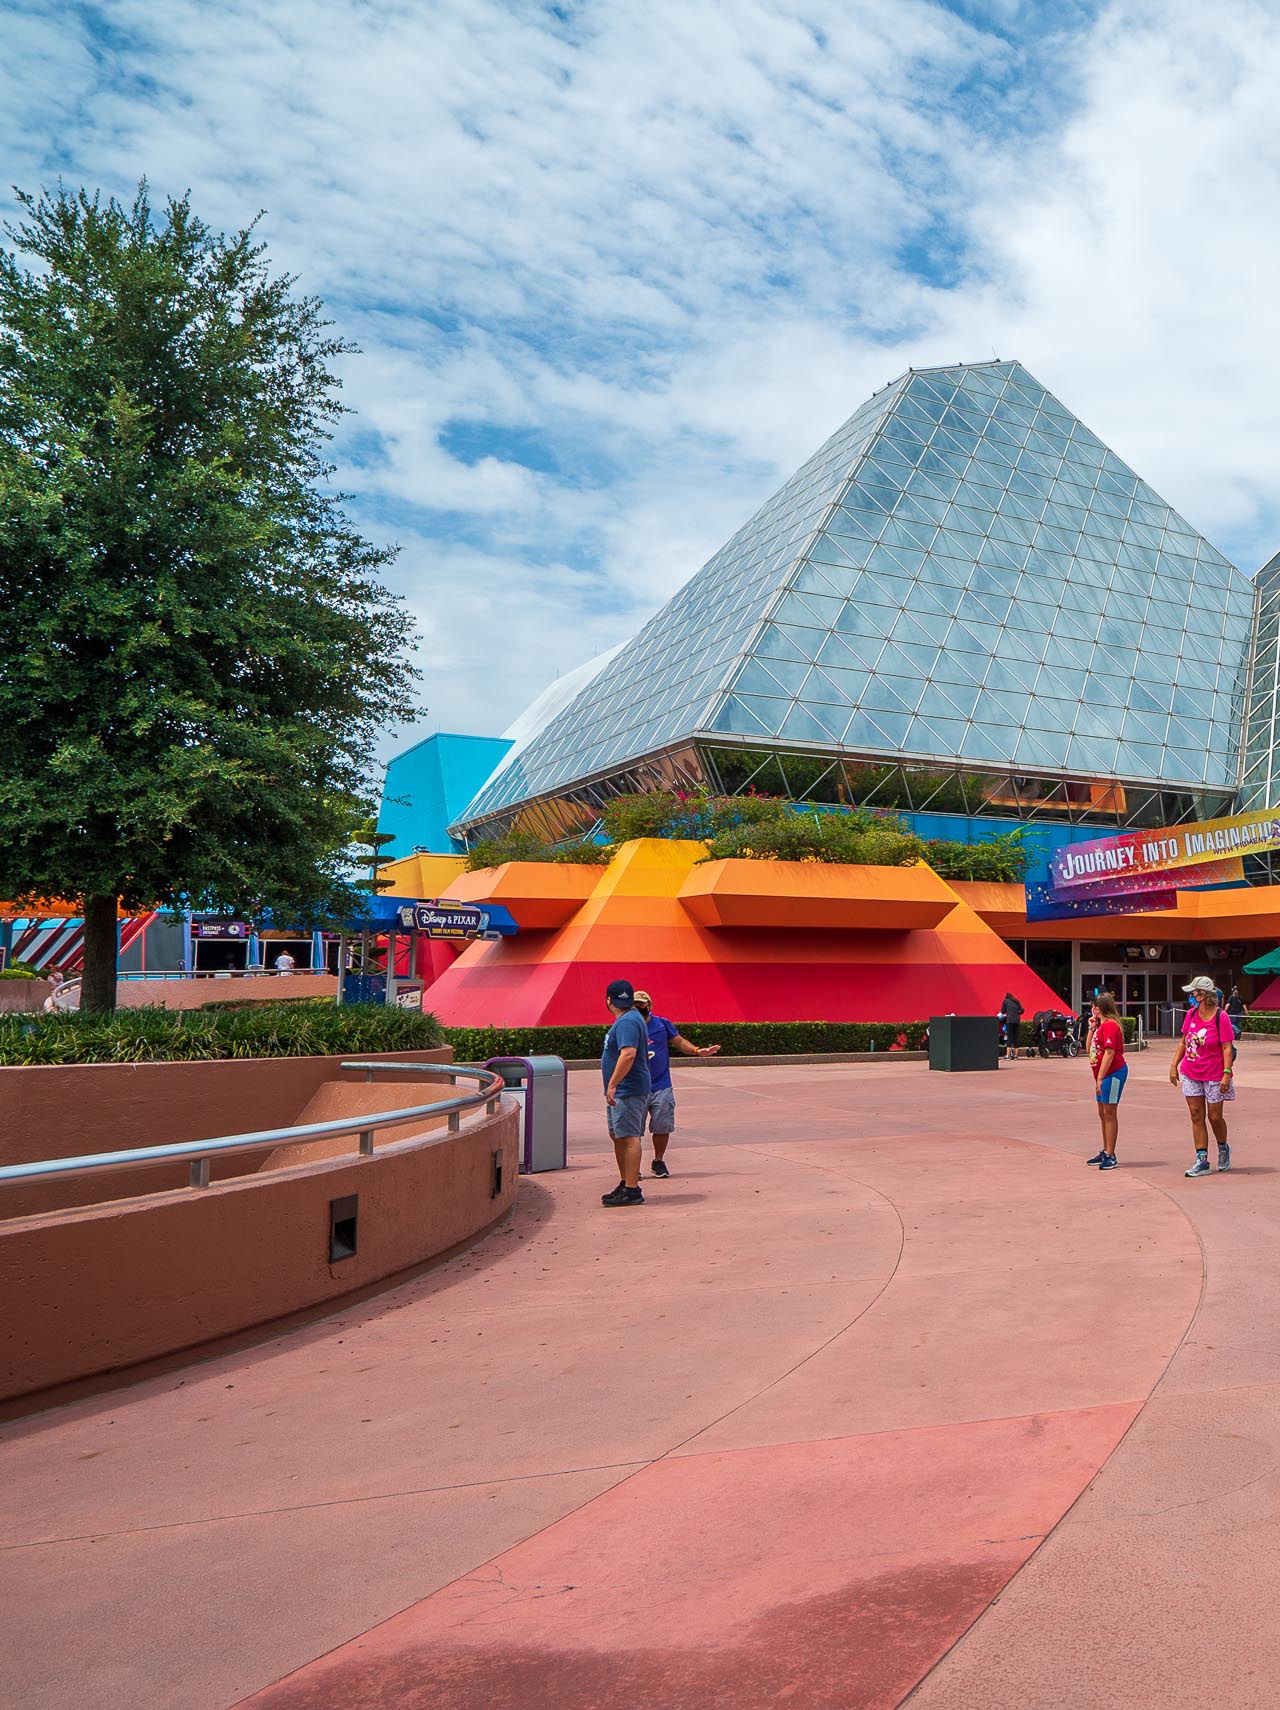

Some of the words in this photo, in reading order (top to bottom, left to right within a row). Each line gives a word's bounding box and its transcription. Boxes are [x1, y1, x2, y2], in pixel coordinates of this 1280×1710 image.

[1062, 846, 1134, 880] JOURNEY
[1142, 837, 1178, 863] INTO
[447, 915, 452, 924] &
[453, 915, 476, 926] PIXAR
